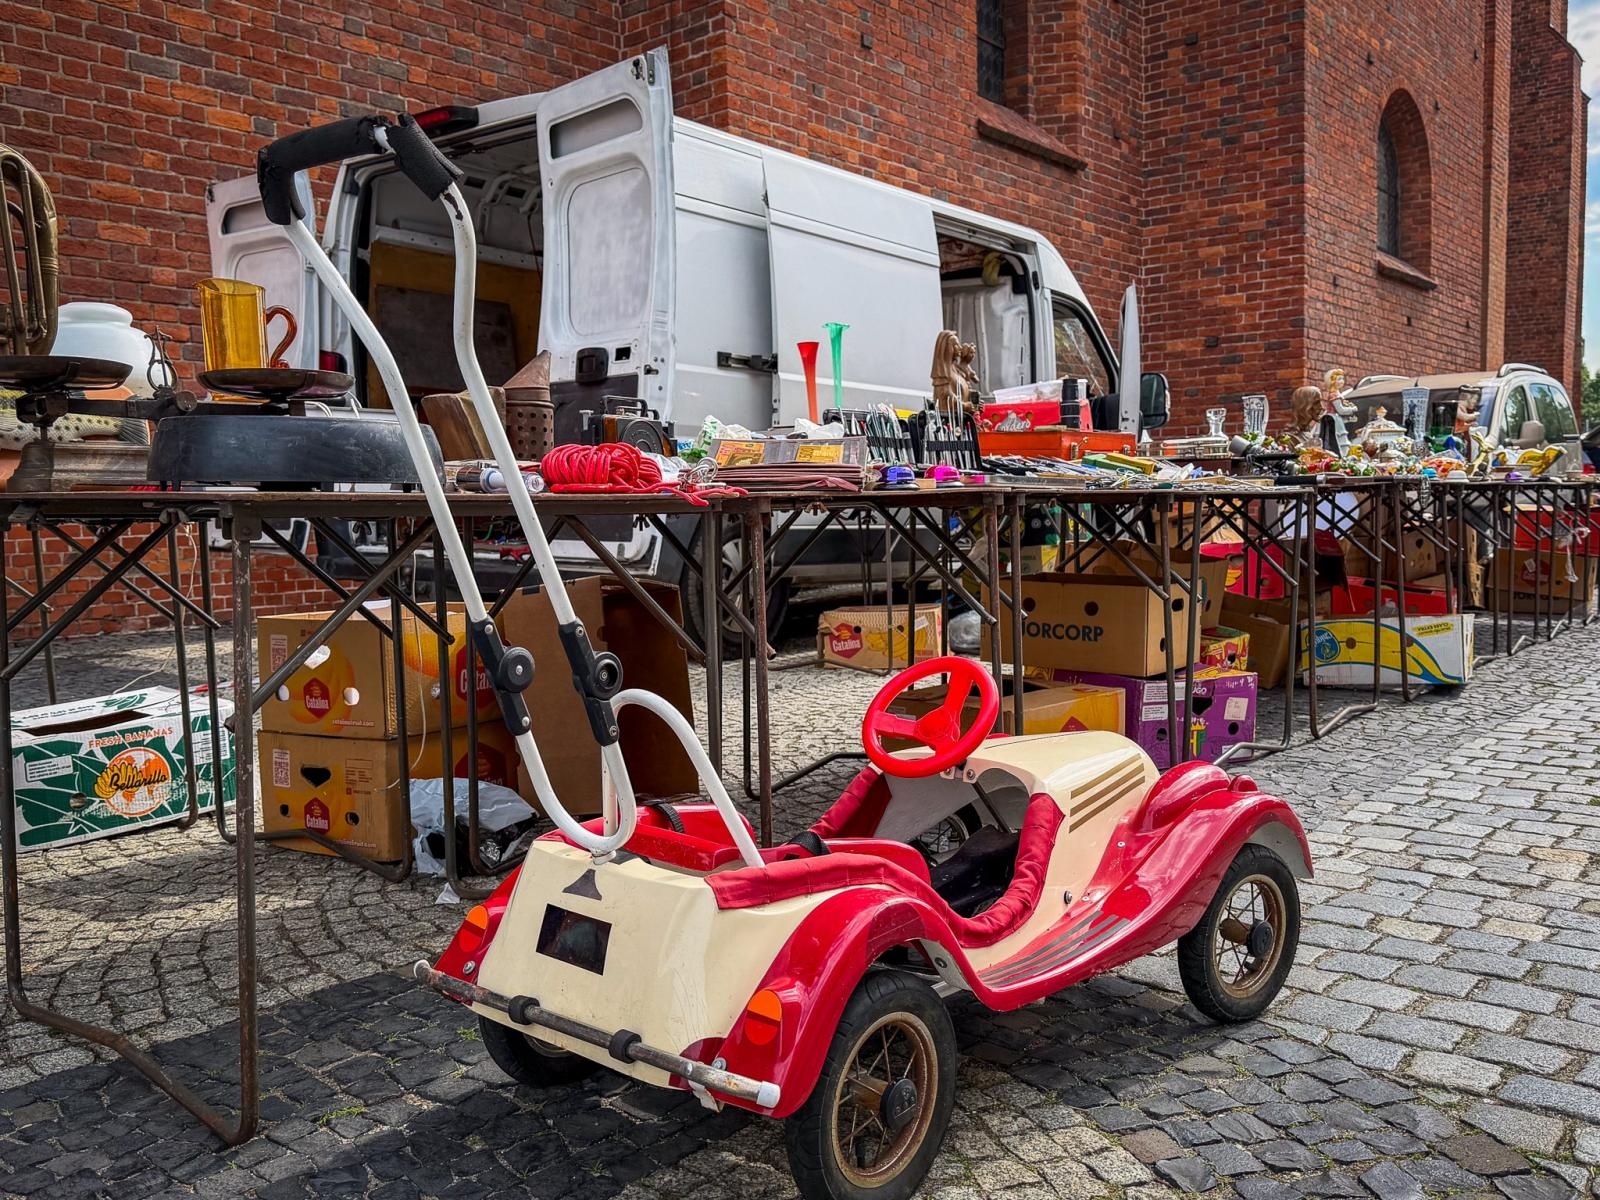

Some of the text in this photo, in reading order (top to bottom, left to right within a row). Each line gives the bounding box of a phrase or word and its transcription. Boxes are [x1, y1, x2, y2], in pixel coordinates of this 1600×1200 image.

[832, 639, 861, 652] Catalina
[305, 695, 329, 709] Catalina
[88, 727, 173, 749] FRESH BANANAS
[109, 769, 167, 791] Bellarillo
[306, 814, 328, 830] Catalina
